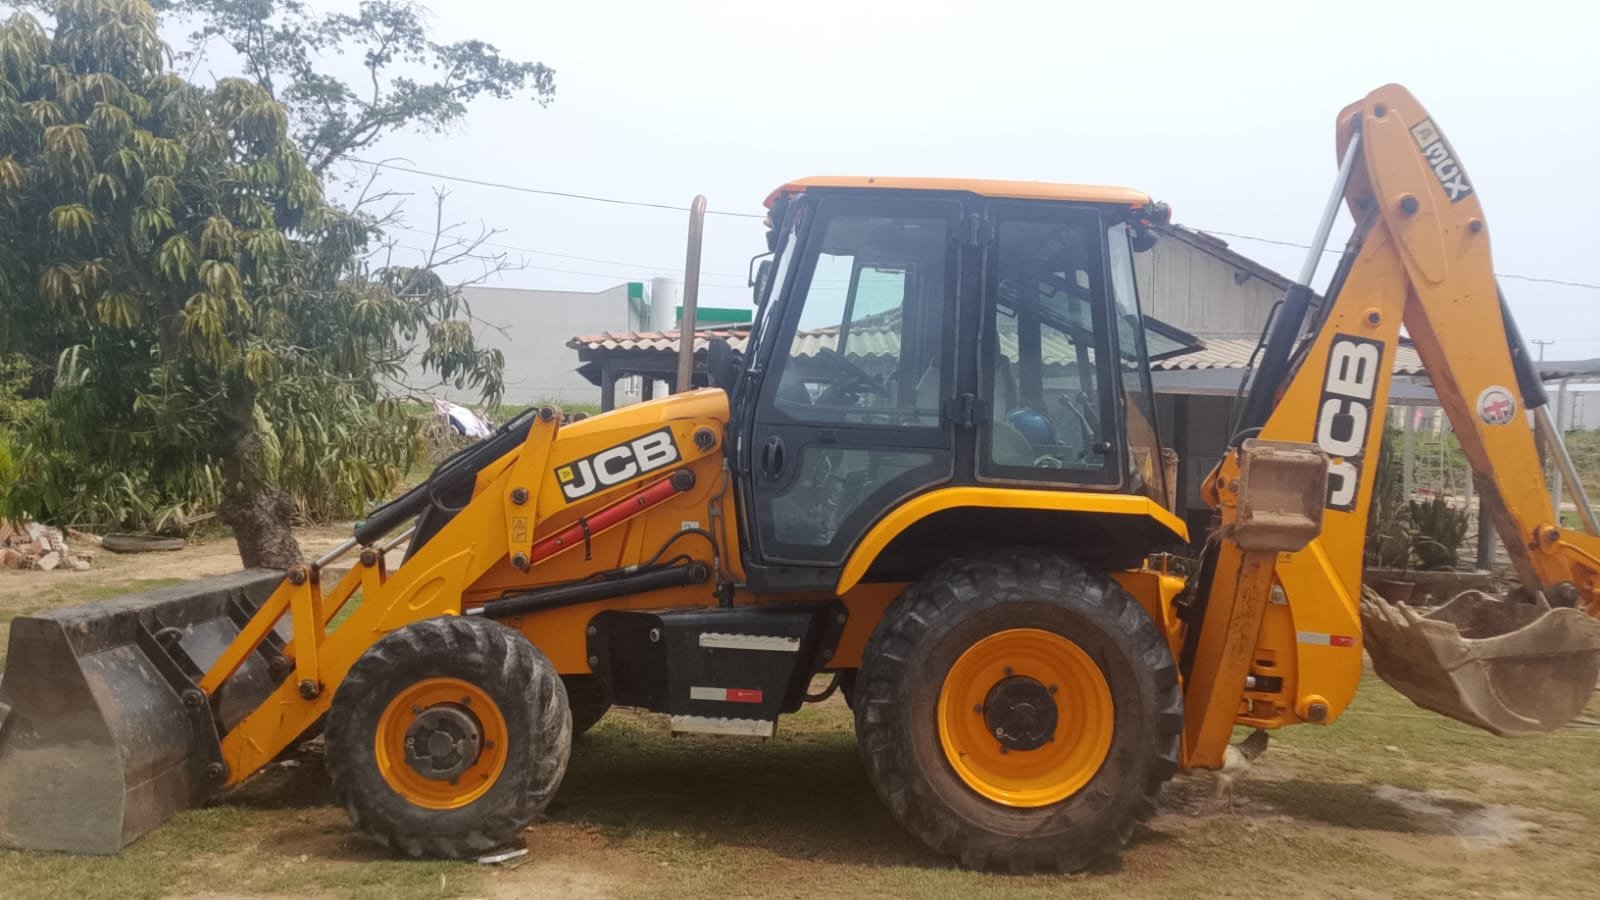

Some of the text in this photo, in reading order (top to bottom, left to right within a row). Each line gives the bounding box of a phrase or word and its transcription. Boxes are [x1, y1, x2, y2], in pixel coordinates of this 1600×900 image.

[1424, 141, 1470, 201] 3CX
[1317, 340, 1379, 506] JCB
[563, 431, 677, 498] JCB
